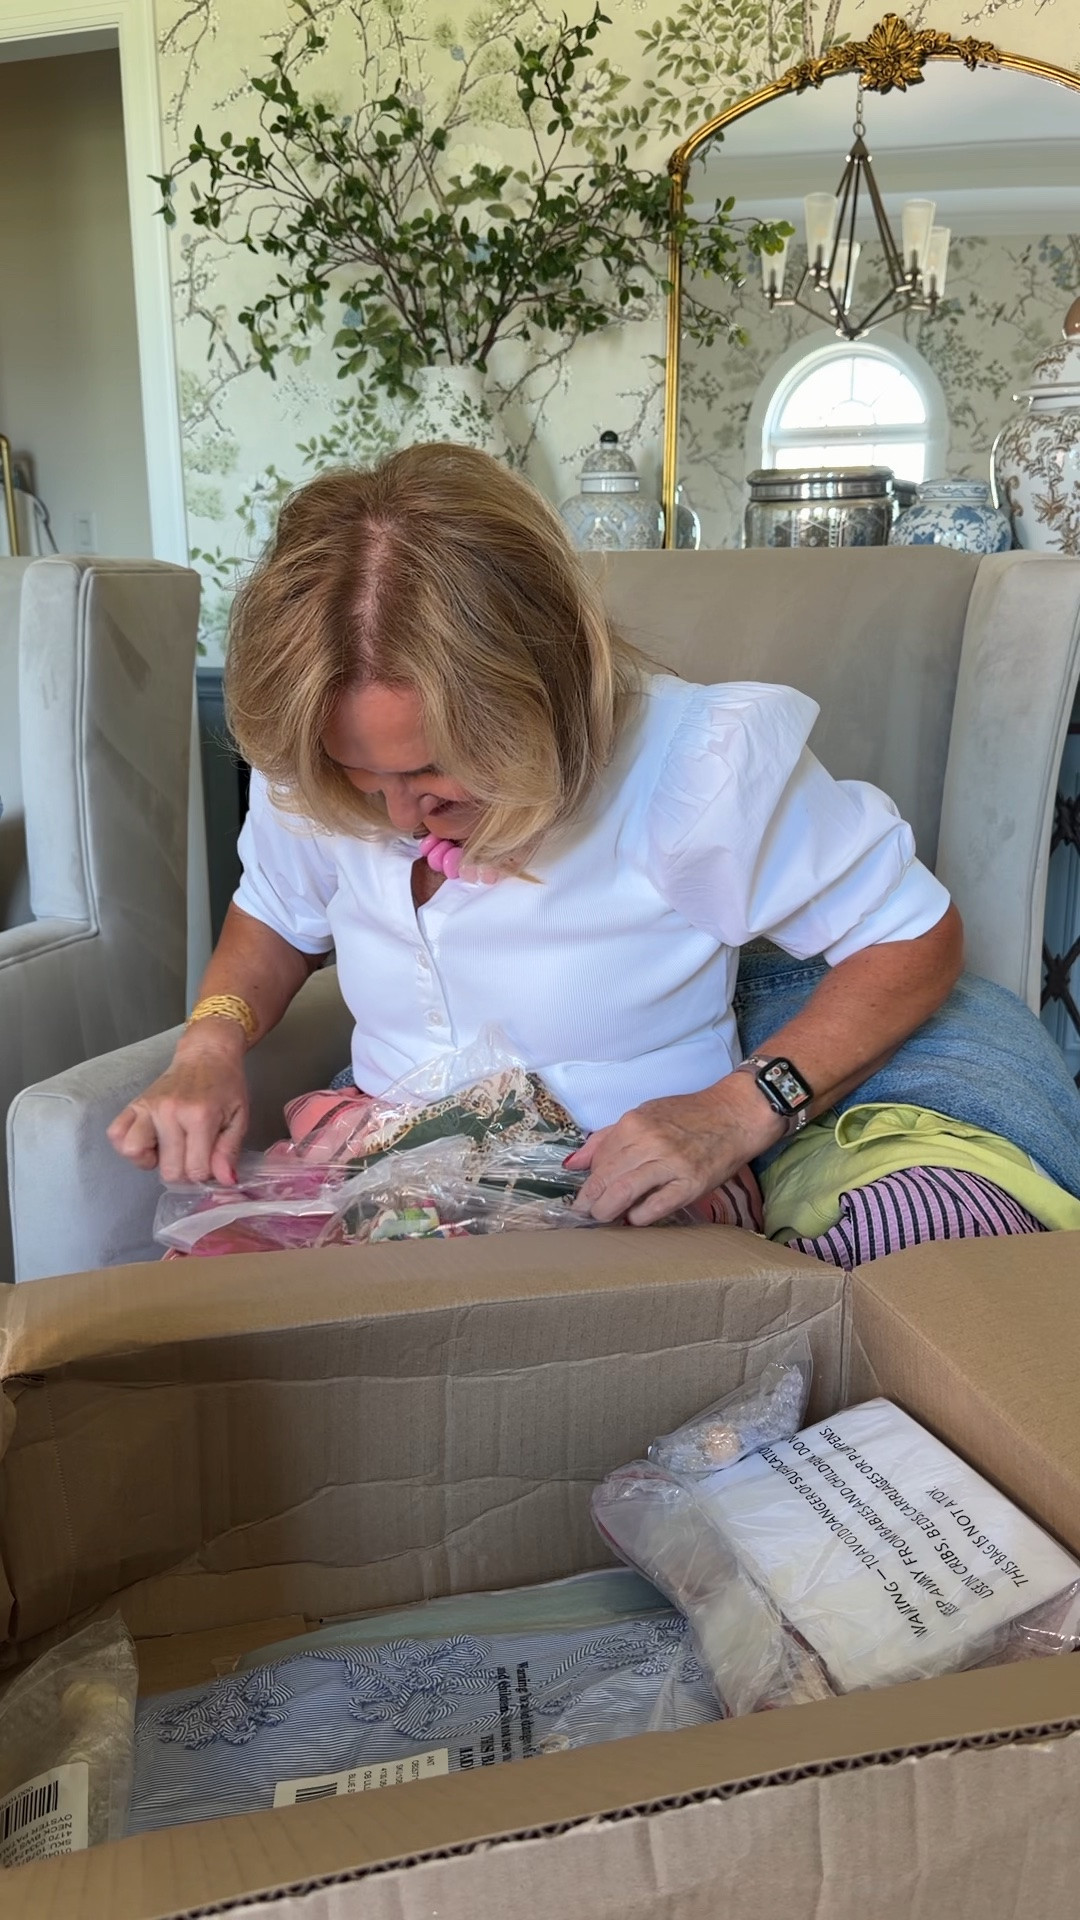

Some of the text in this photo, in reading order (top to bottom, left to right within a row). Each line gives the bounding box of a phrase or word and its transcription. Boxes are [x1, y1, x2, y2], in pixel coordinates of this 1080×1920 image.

[792, 1441, 810, 1456] DO
[854, 1459, 873, 1473] OR
[793, 1483, 812, 1494] OF
[839, 1487, 865, 1508] AND
[866, 1472, 917, 1516] CARRIAGES
[804, 1491, 843, 1531] DANGER
[856, 1505, 892, 1537] BABIES
[910, 1511, 940, 1538] BEDS,
[925, 1485, 1028, 1587] THIS BAG IS NOT A TOY.
[836, 1528, 869, 1556] AVOID
[883, 1532, 917, 1565] FROM
[860, 1554, 879, 1569] TO
[933, 1538, 968, 1574] CRIBS,
[909, 1570, 944, 1596] AWAY
[960, 1573, 979, 1587] IN
[970, 1581, 994, 1599] USE
[883, 1581, 927, 1637] WAING
[32, 1814, 72, 1834] OYSTER
[44, 1822, 72, 1835] NECK
